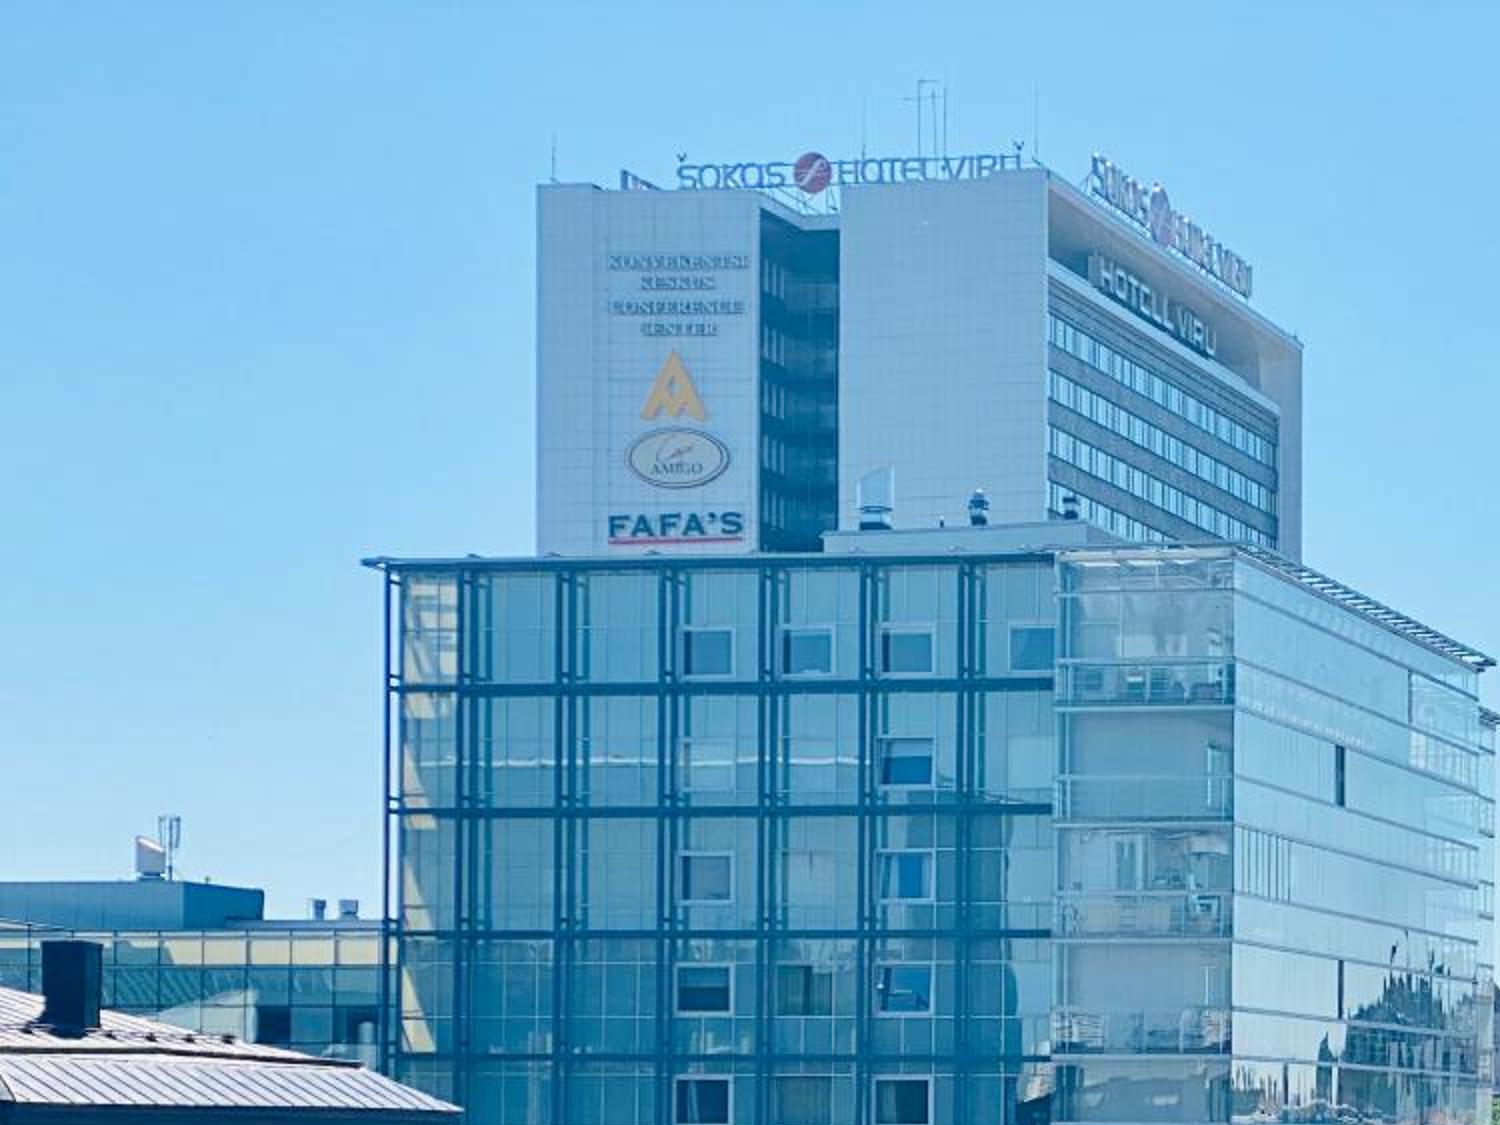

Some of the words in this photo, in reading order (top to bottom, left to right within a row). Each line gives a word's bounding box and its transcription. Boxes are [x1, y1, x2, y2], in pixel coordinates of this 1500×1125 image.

[677, 161, 786, 190] SOKOS
[838, 154, 938, 186] HOTEL
[1101, 258, 1175, 331] HOTELL
[1177, 304, 1217, 357] VIRU
[651, 463, 703, 475] AMIGO
[608, 512, 743, 538] FAFA'S
